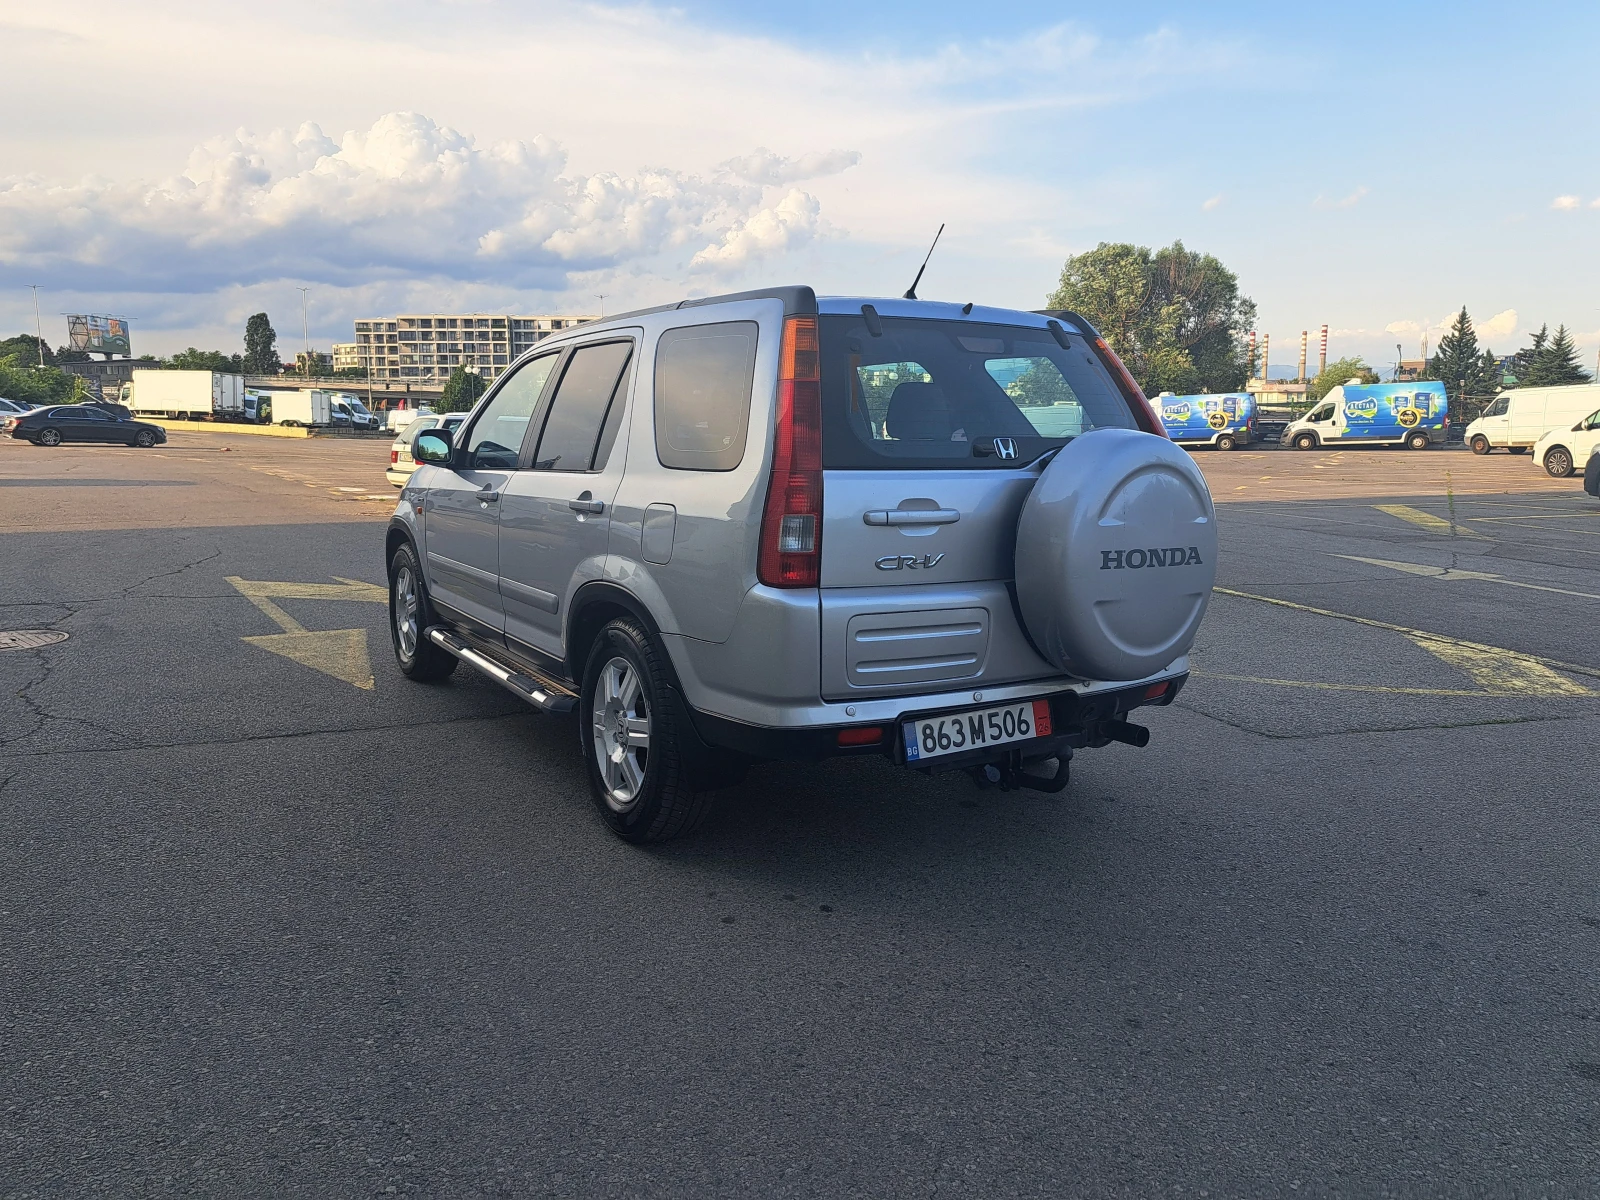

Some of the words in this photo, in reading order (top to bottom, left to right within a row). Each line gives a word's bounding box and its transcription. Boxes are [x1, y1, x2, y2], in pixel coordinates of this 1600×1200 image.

[875, 553, 946, 571] CR-V
[1100, 546, 1203, 570] HONDA
[907, 746, 918, 757] BG
[922, 707, 1030, 753] 863M506
